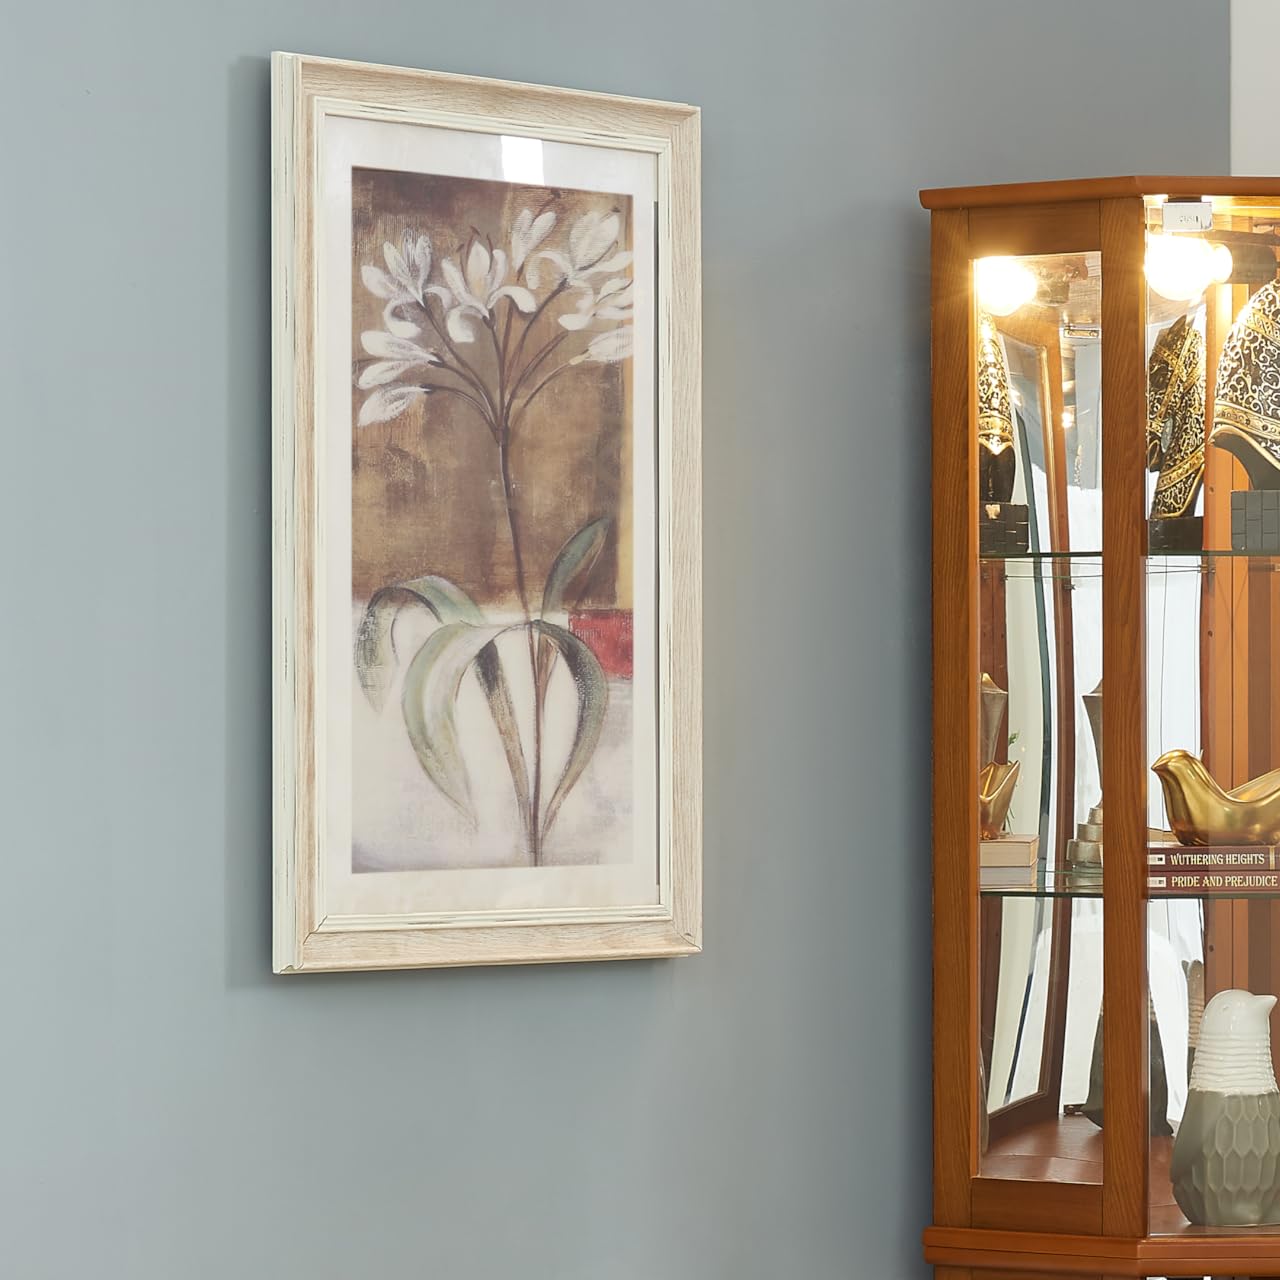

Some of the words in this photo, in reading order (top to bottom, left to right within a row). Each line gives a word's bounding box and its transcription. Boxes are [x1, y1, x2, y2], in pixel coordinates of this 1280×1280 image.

[1170, 853, 1224, 865] WUTHERING
[1225, 853, 1265, 865] HEIGHTS
[1171, 875, 1200, 888] PRIDE
[1202, 876, 1223, 887] AND
[1225, 875, 1278, 888] PREJUDICE
